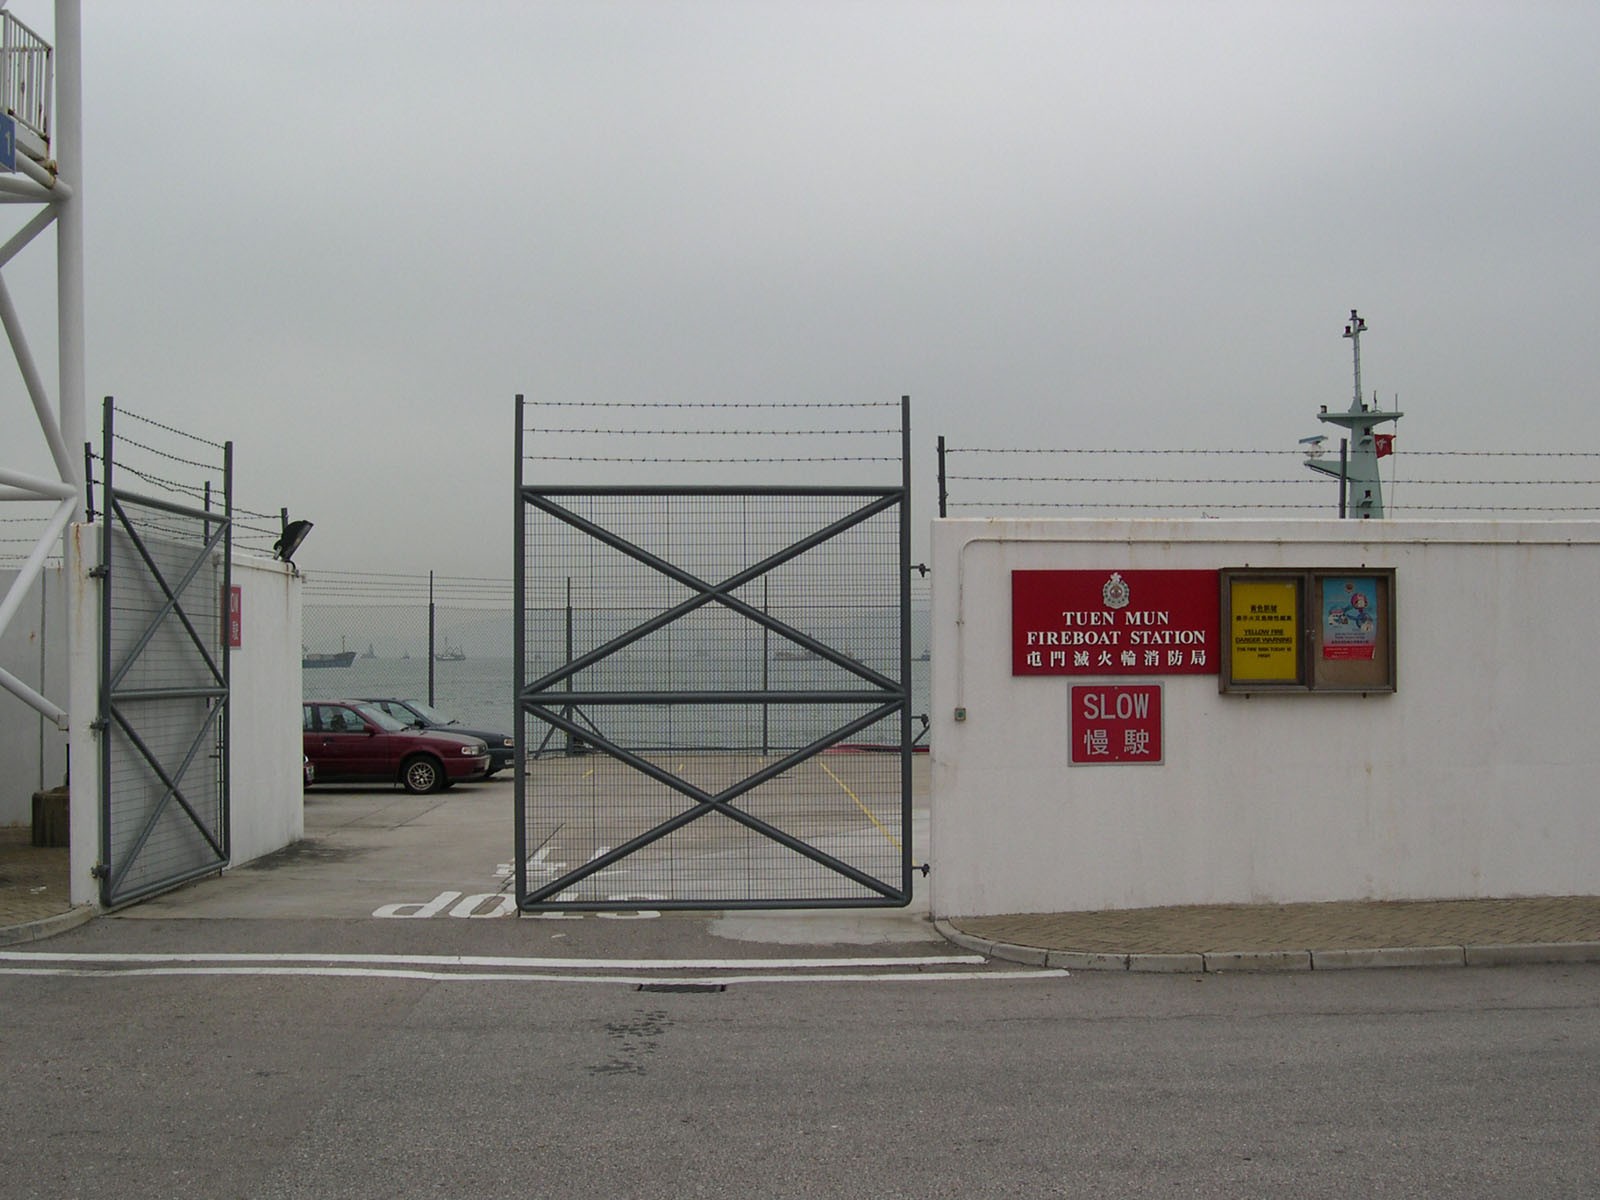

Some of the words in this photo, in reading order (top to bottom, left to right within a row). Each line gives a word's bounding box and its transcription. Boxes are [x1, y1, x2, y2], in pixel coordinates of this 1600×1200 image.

[1062, 611, 1115, 626] TUEN
[1125, 611, 1169, 626] MUN
[1027, 630, 1121, 645] FIREBOAT
[1130, 630, 1206, 645] STATION
[1027, 649, 1206, 668] 屯門滅火輪消防局
[1083, 693, 1149, 720] SLOW
[1083, 728, 1150, 755] 慢駛
